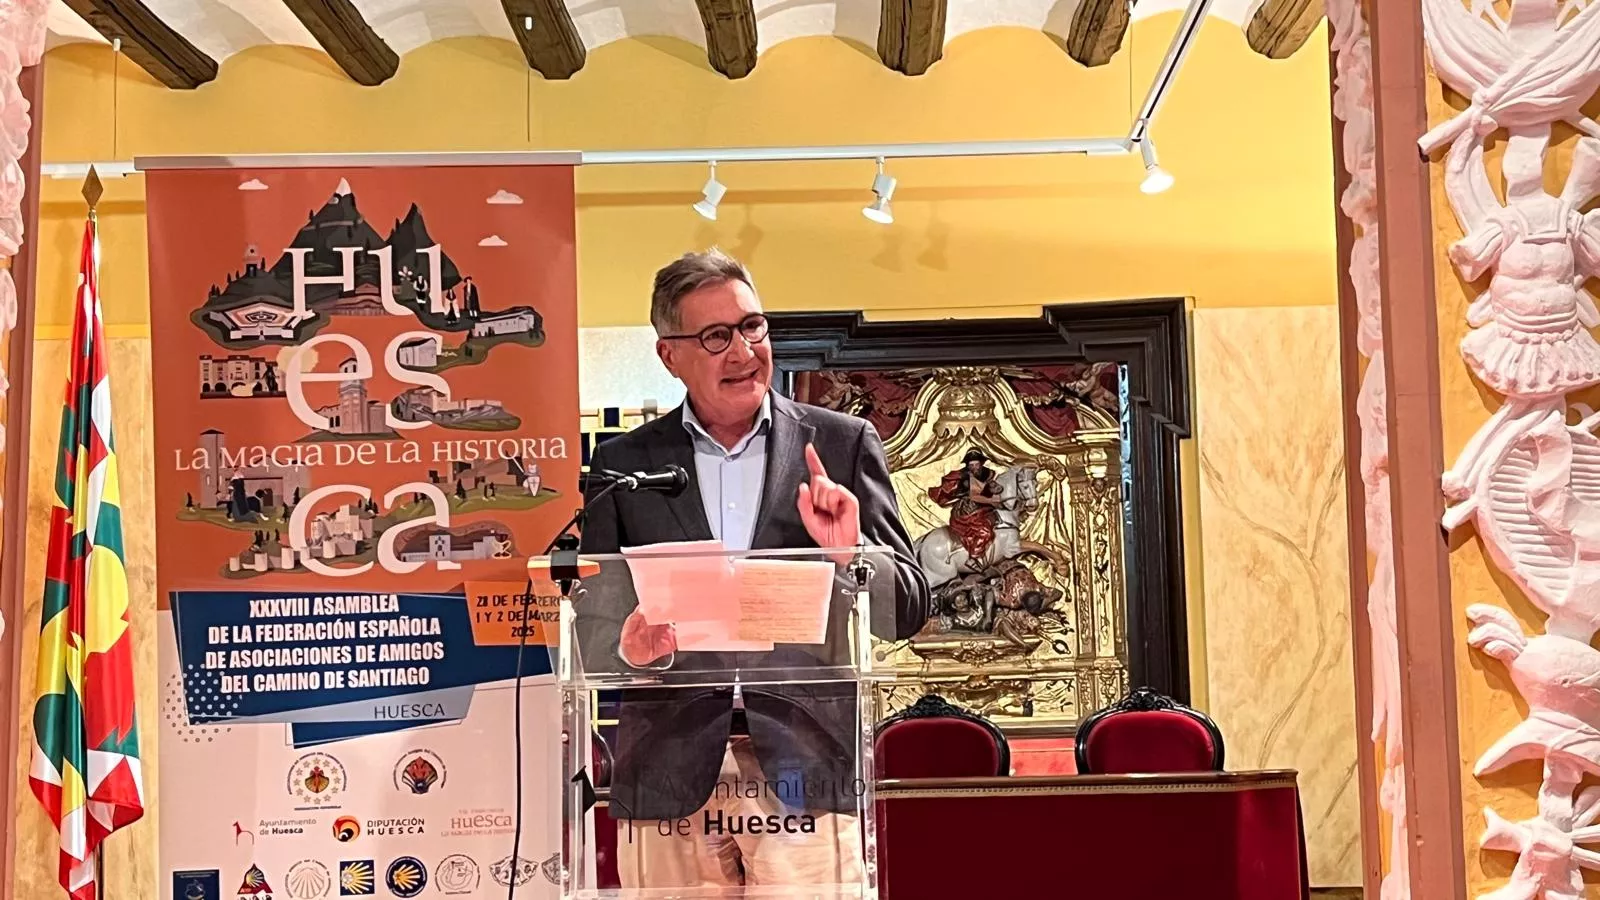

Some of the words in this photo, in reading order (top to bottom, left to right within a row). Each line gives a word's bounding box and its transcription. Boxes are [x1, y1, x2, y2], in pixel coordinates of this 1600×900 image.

[250, 598, 309, 618] XXXVIII
[313, 594, 399, 615] ASAMBLEA
[493, 594, 508, 607] DE
[484, 611, 492, 622] Y
[496, 611, 504, 622] 2
[508, 610, 524, 622] DE
[528, 609, 560, 622] MARZ
[208, 625, 230, 644] DE
[233, 624, 252, 643] LA
[255, 618, 355, 642] FEDERACIÓN
[359, 616, 441, 638] ESPAÑOLA
[205, 651, 227, 669] DE
[229, 645, 351, 668] ASOCIACIONES
[355, 644, 376, 663] DE
[378, 641, 444, 662] AMIGOS
[220, 674, 250, 694] DEL
[254, 671, 319, 692] CAMINO
[324, 670, 345, 689] DE
[348, 666, 430, 688] SANTIAGO
[374, 703, 446, 719] HUESCA
[367, 817, 425, 828] DIPUTACIÓN
[450, 814, 513, 829] Huesca
[658, 812, 691, 837] de
[704, 809, 816, 836] Huesca
[272, 827, 304, 835] Huesca
[367, 826, 425, 836] HUESCA
